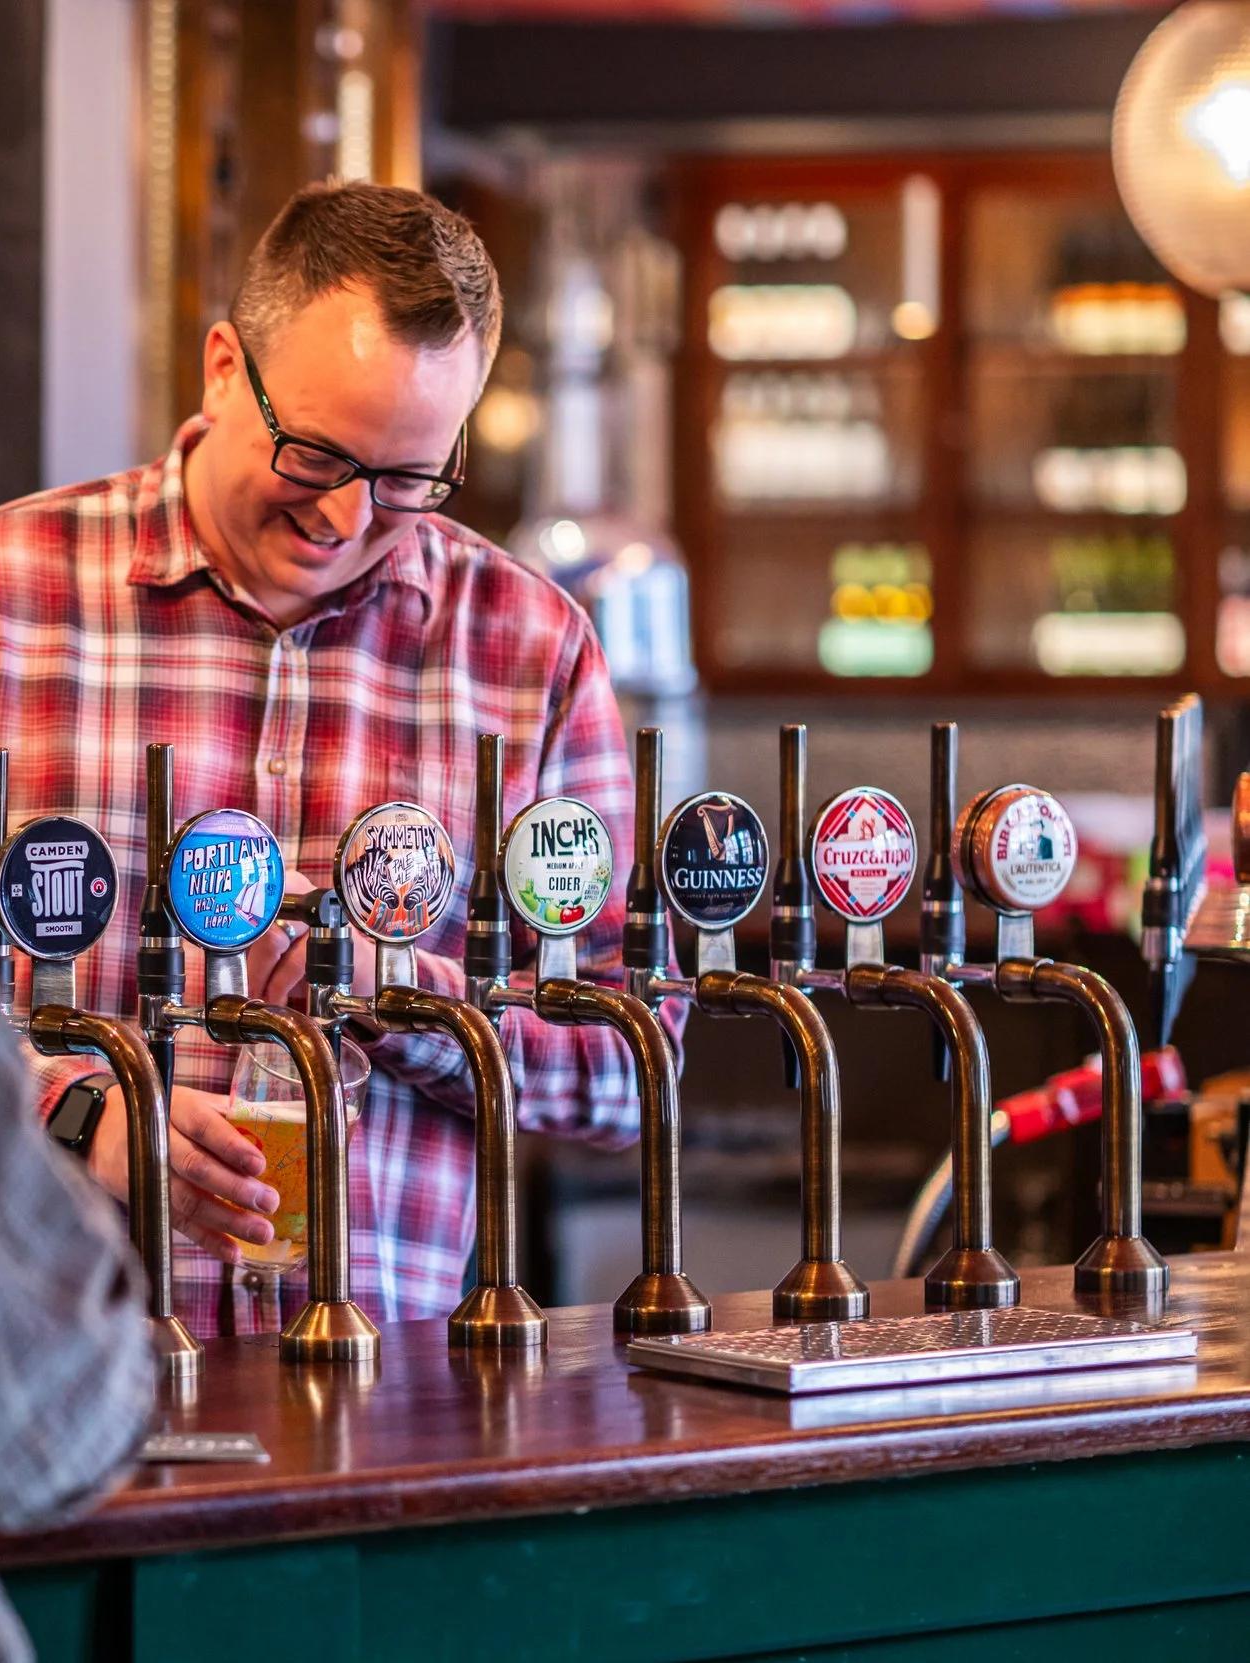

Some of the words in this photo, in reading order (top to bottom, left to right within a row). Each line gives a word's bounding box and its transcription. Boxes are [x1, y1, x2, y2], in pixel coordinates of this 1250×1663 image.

[365, 825, 438, 850] SYMMETRY
[530, 817, 599, 858] INCH'S
[30, 845, 83, 857] CAMDEN
[181, 837, 271, 872] PORTLAND
[393, 852, 414, 874] PALE
[547, 862, 567, 870] MEDIUM
[1011, 862, 1062, 875] L'AUTENTICA
[188, 869, 232, 896] NEIPA
[395, 873, 411, 886] ALE
[548, 877, 581, 891] CIDER
[674, 867, 763, 889] GUINNESS
[30, 860, 84, 917] STOUT
[194, 897, 216, 913] HAZY
[45, 925, 73, 933] SMOOTH
[204, 915, 234, 929] HOPPY
